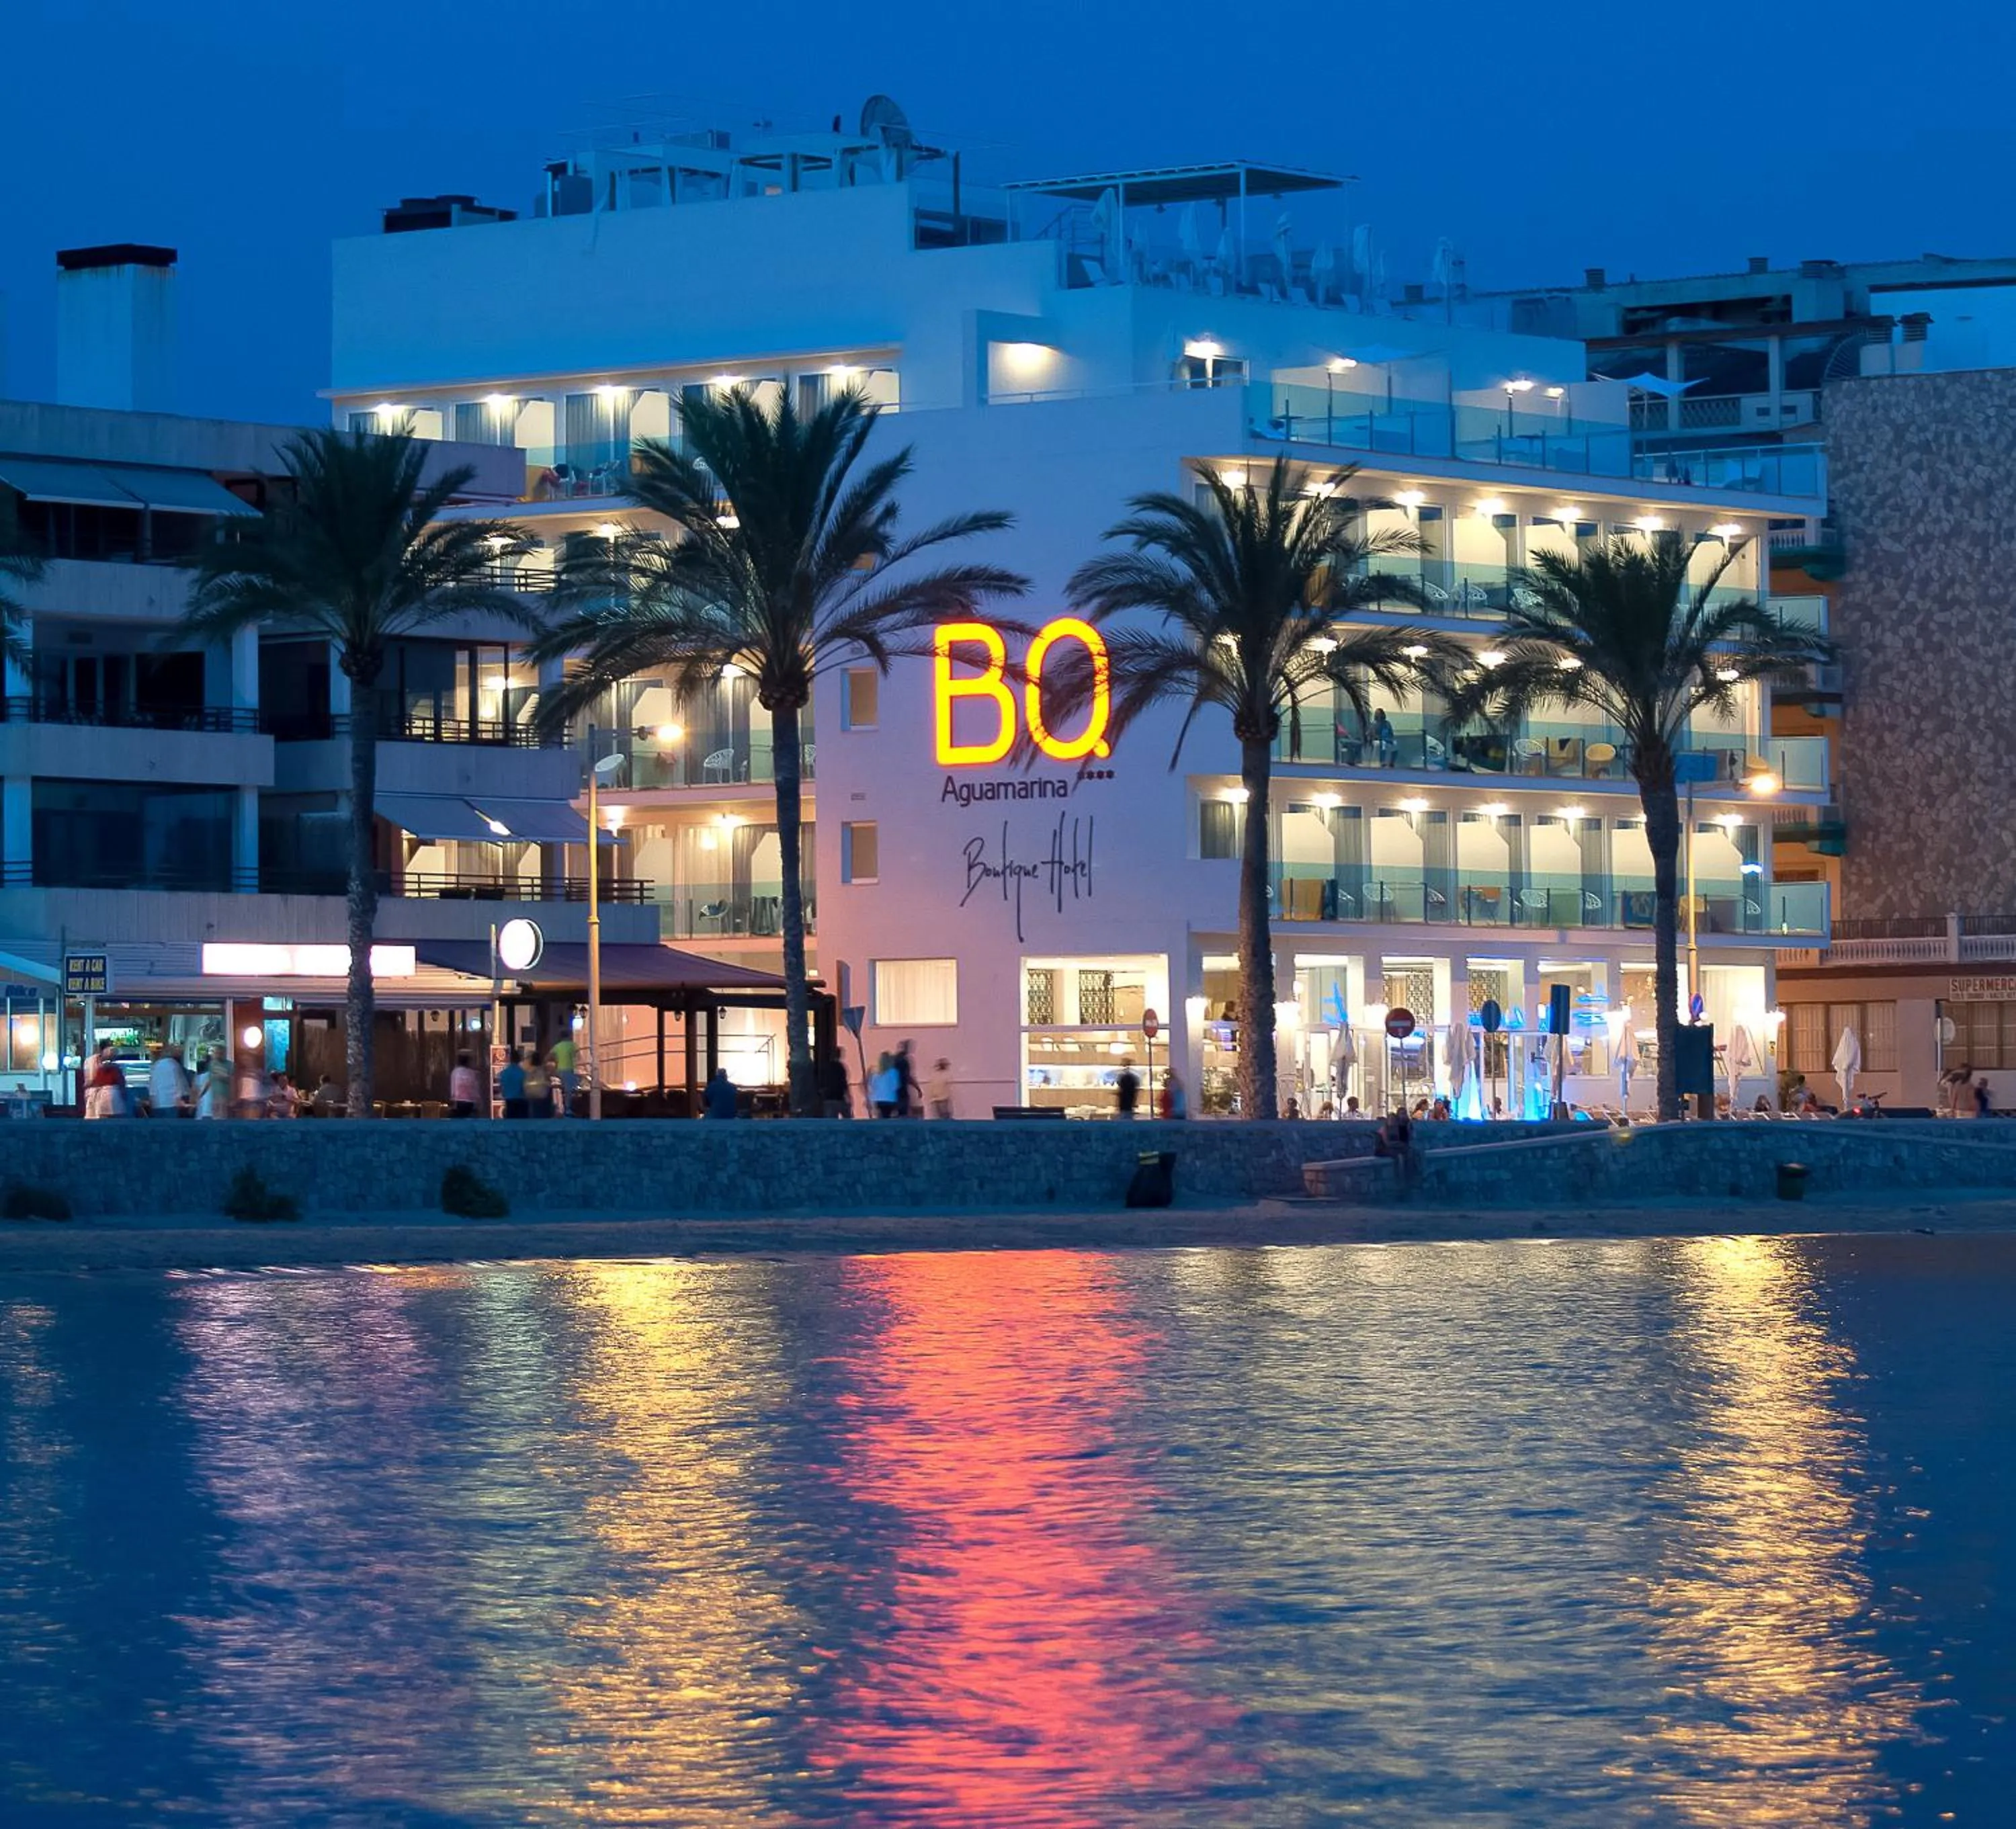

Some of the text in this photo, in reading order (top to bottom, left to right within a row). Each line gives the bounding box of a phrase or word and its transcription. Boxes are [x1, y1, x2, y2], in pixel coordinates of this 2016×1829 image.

[935, 618, 1110, 765] BQ
[941, 775, 1068, 807] Aguamarina
[959, 810, 1094, 943] Boutique Hotel
[1951, 978, 2016, 992] SUPERMERC
